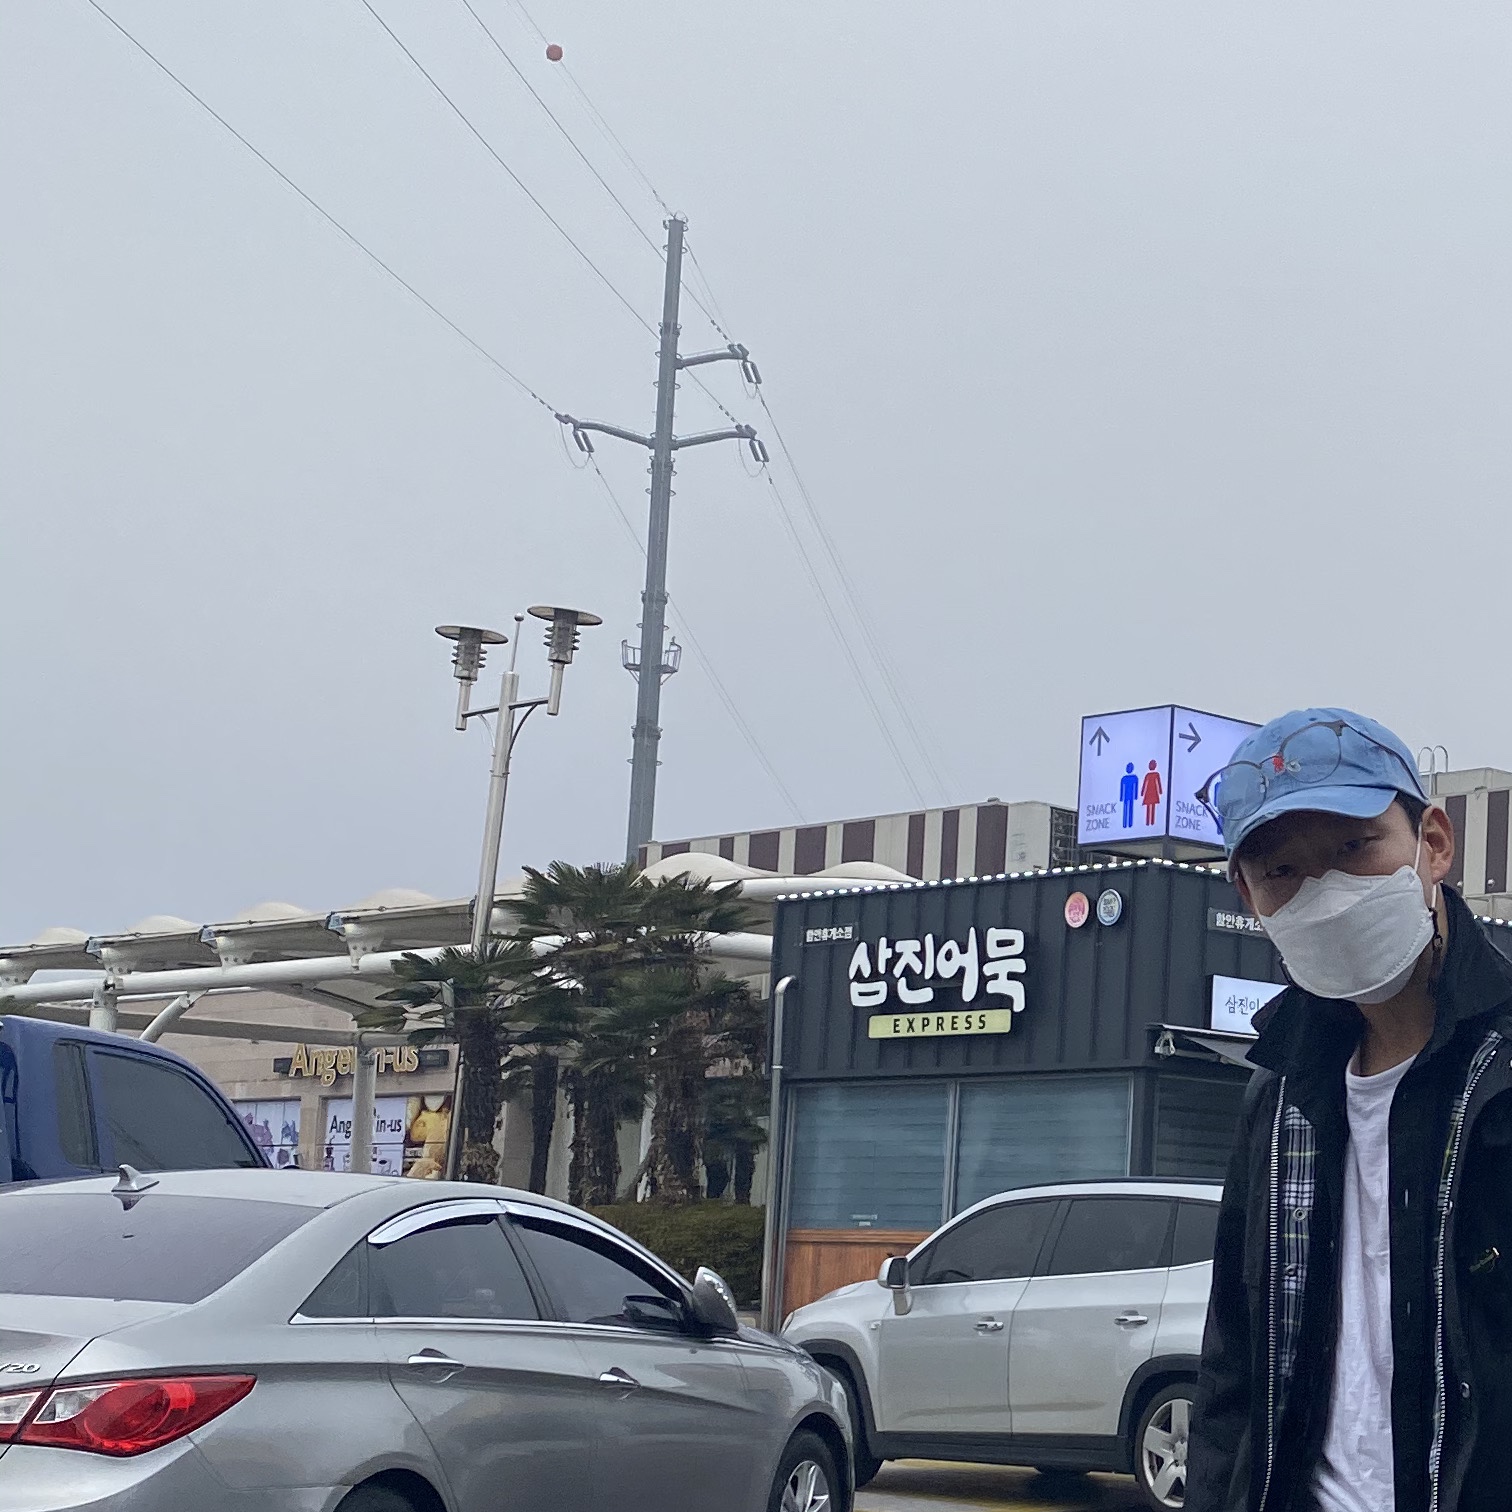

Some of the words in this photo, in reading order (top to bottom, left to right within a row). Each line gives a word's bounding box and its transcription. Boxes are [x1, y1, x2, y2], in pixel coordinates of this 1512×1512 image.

[1086, 802, 1117, 817] SNACK
[1086, 817, 1110, 832] ZONE
[1175, 815, 1201, 832] ZONE
[849, 926, 1027, 1012] 삼진어묵
[893, 1013, 987, 1034] EXPRESS
